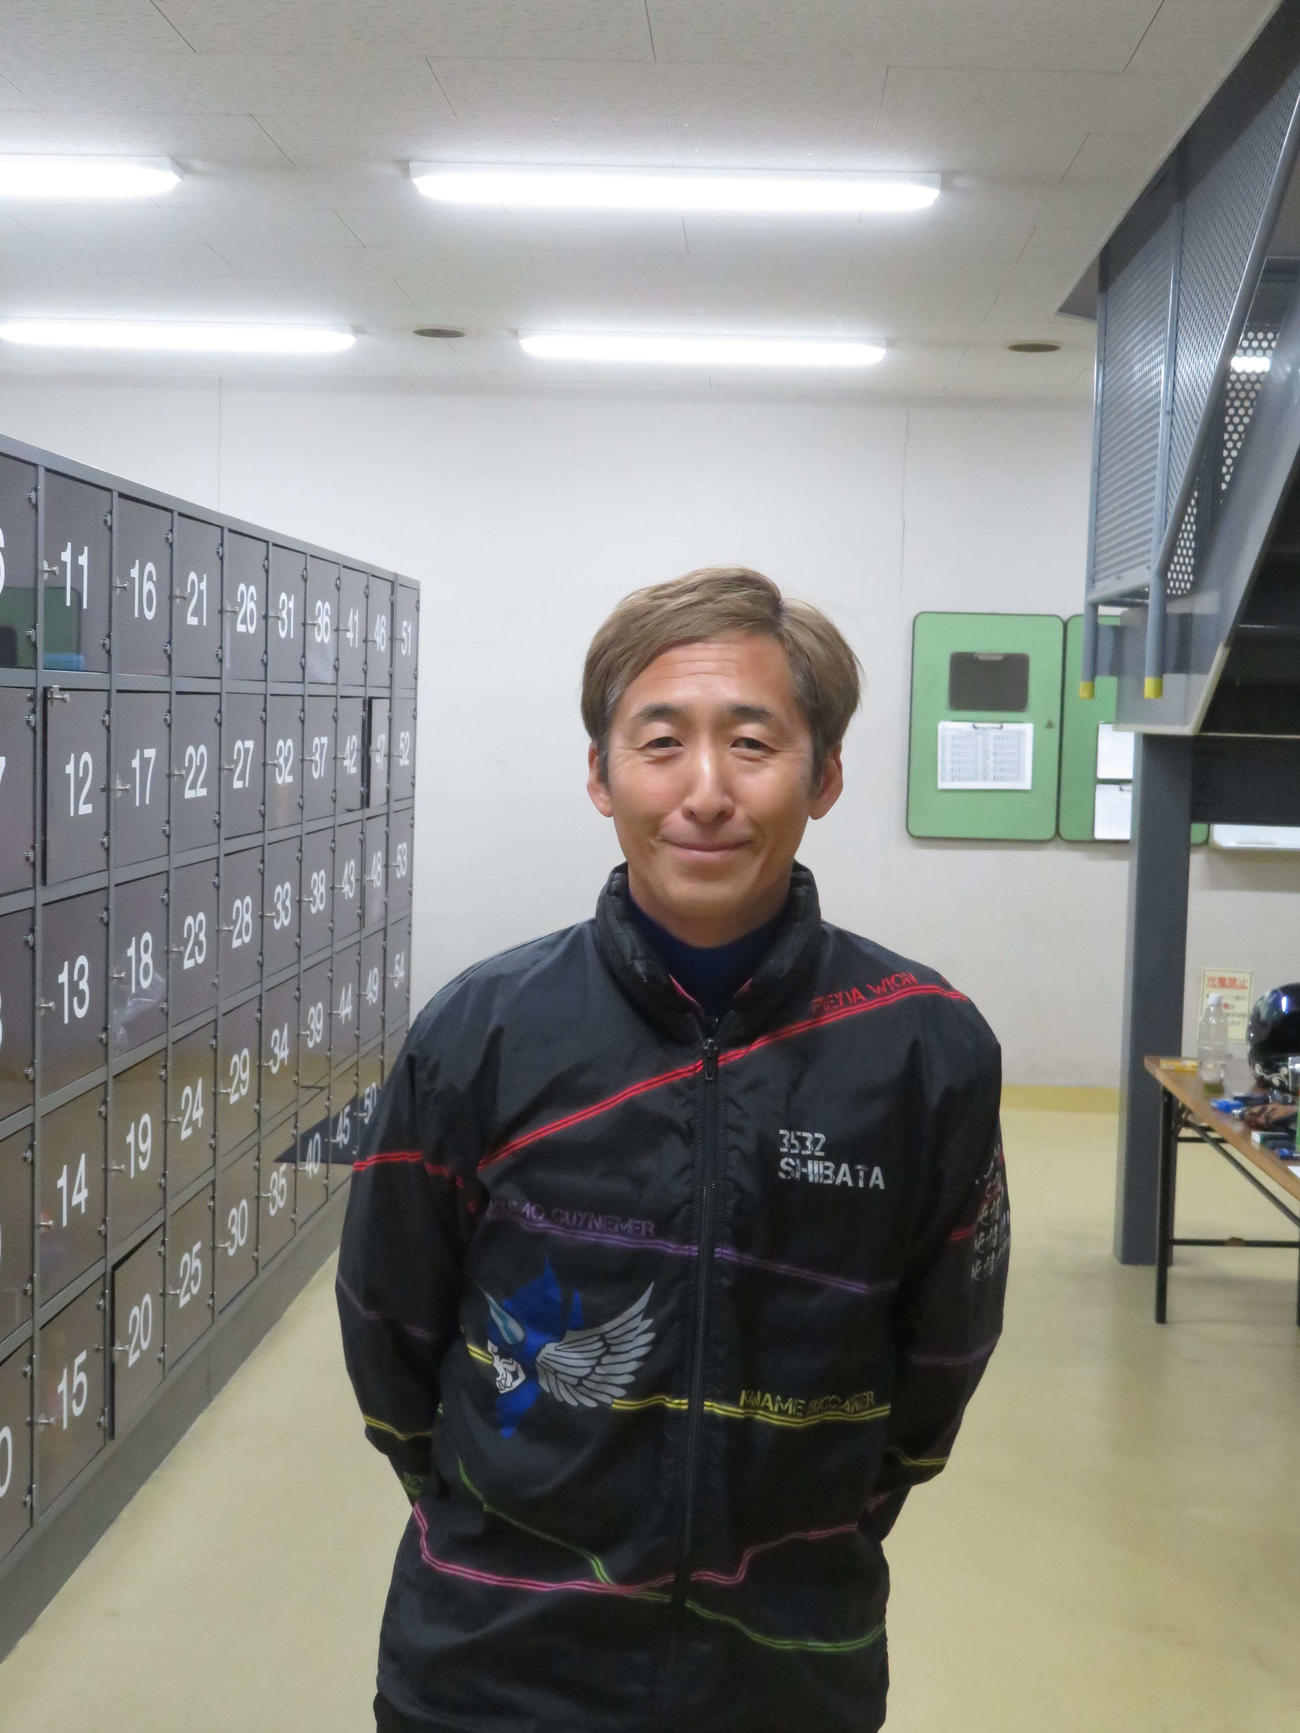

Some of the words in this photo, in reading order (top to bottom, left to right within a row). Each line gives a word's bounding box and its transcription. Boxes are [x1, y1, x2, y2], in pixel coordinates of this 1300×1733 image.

[61, 542, 88, 609] 11
[130, 560, 156, 620] 16
[187, 571, 207, 626] 21
[236, 583, 257, 634] 26
[279, 593, 294, 639] 31
[315, 600, 331, 644] 36
[347, 609, 359, 647] 41
[373, 614, 386, 652] 46
[401, 621, 412, 656] 51
[185, 745, 207, 799] 22
[233, 740, 254, 789] 27
[276, 739, 294, 784] 32
[312, 737, 328, 780] 37
[344, 735, 357, 774] 42
[399, 732, 410, 766] 52
[65, 752, 93, 817] 12
[131, 748, 157, 807] 17
[343, 860, 355, 900] 43
[370, 851, 382, 888] 48
[396, 843, 407, 879] 53
[274, 881, 291, 930] 33
[310, 869, 326, 914] 38
[183, 912, 206, 970] 23
[232, 895, 252, 949] 28
[127, 932, 153, 994] 18
[365, 966, 379, 1006] 49
[58, 955, 90, 1024] 13
[339, 983, 352, 1025] 44
[271, 1023, 289, 1074] 34
[308, 1002, 323, 1048] 39
[230, 1049, 249, 1104] 29
[180, 1078, 204, 1141] 24
[337, 1105, 351, 1149] 45
[363, 1081, 377, 1125] 50
[126, 1113, 152, 1179] 19
[306, 1132, 321, 1179] 40
[778, 1129, 827, 1156] 3532
[56, 1153, 88, 1227] 14
[269, 1164, 287, 1217] 35
[778, 1157, 886, 1191] SHIBATA
[228, 1200, 248, 1257] 30
[179, 1241, 202, 1309] 25
[128, 1293, 152, 1368] 20
[57, 1350, 88, 1431] 15
